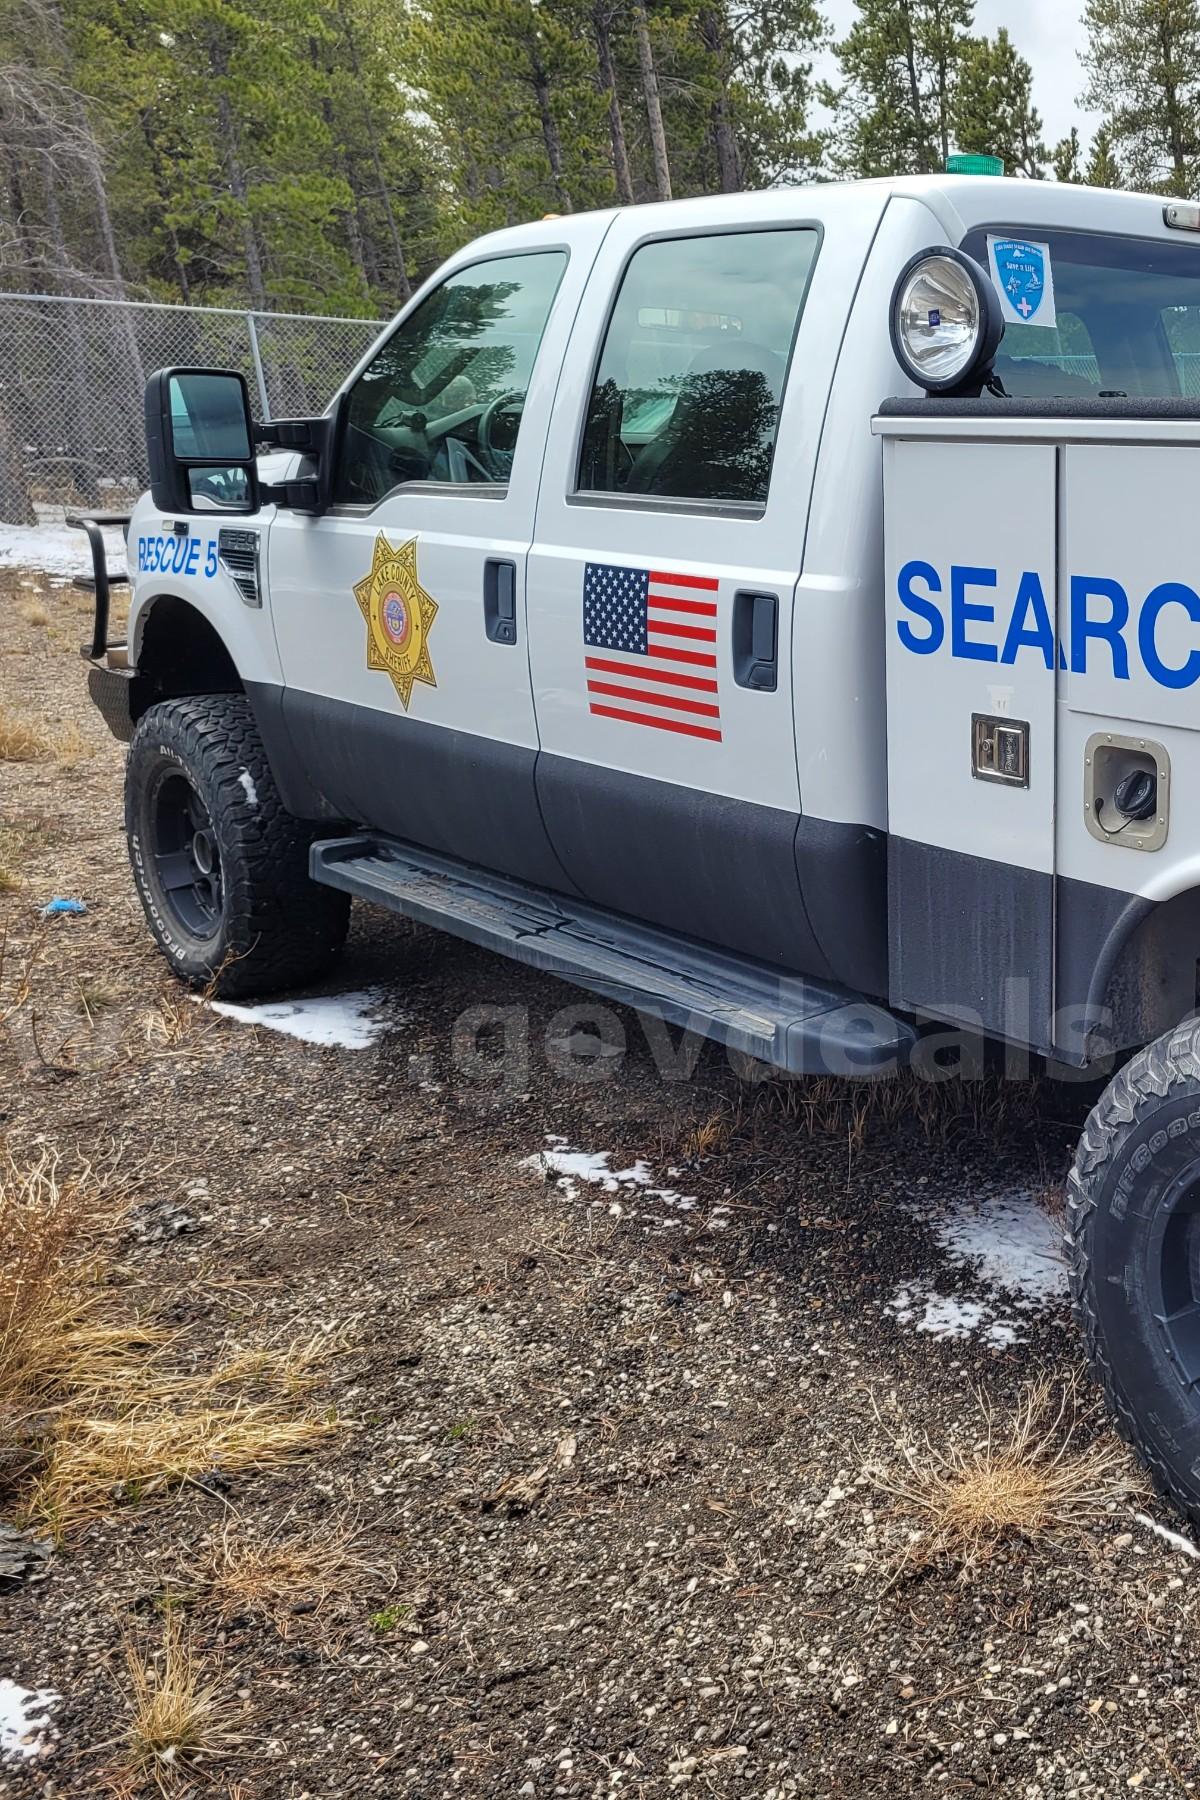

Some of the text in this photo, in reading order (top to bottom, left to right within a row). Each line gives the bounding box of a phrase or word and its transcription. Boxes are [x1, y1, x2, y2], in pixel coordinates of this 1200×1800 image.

[138, 537, 218, 578] RESCUE 5
[373, 563, 416, 600] LAKE COUNTY
[384, 646, 412, 670] SHERIFF
[132, 834, 187, 961] BFGoodrich
